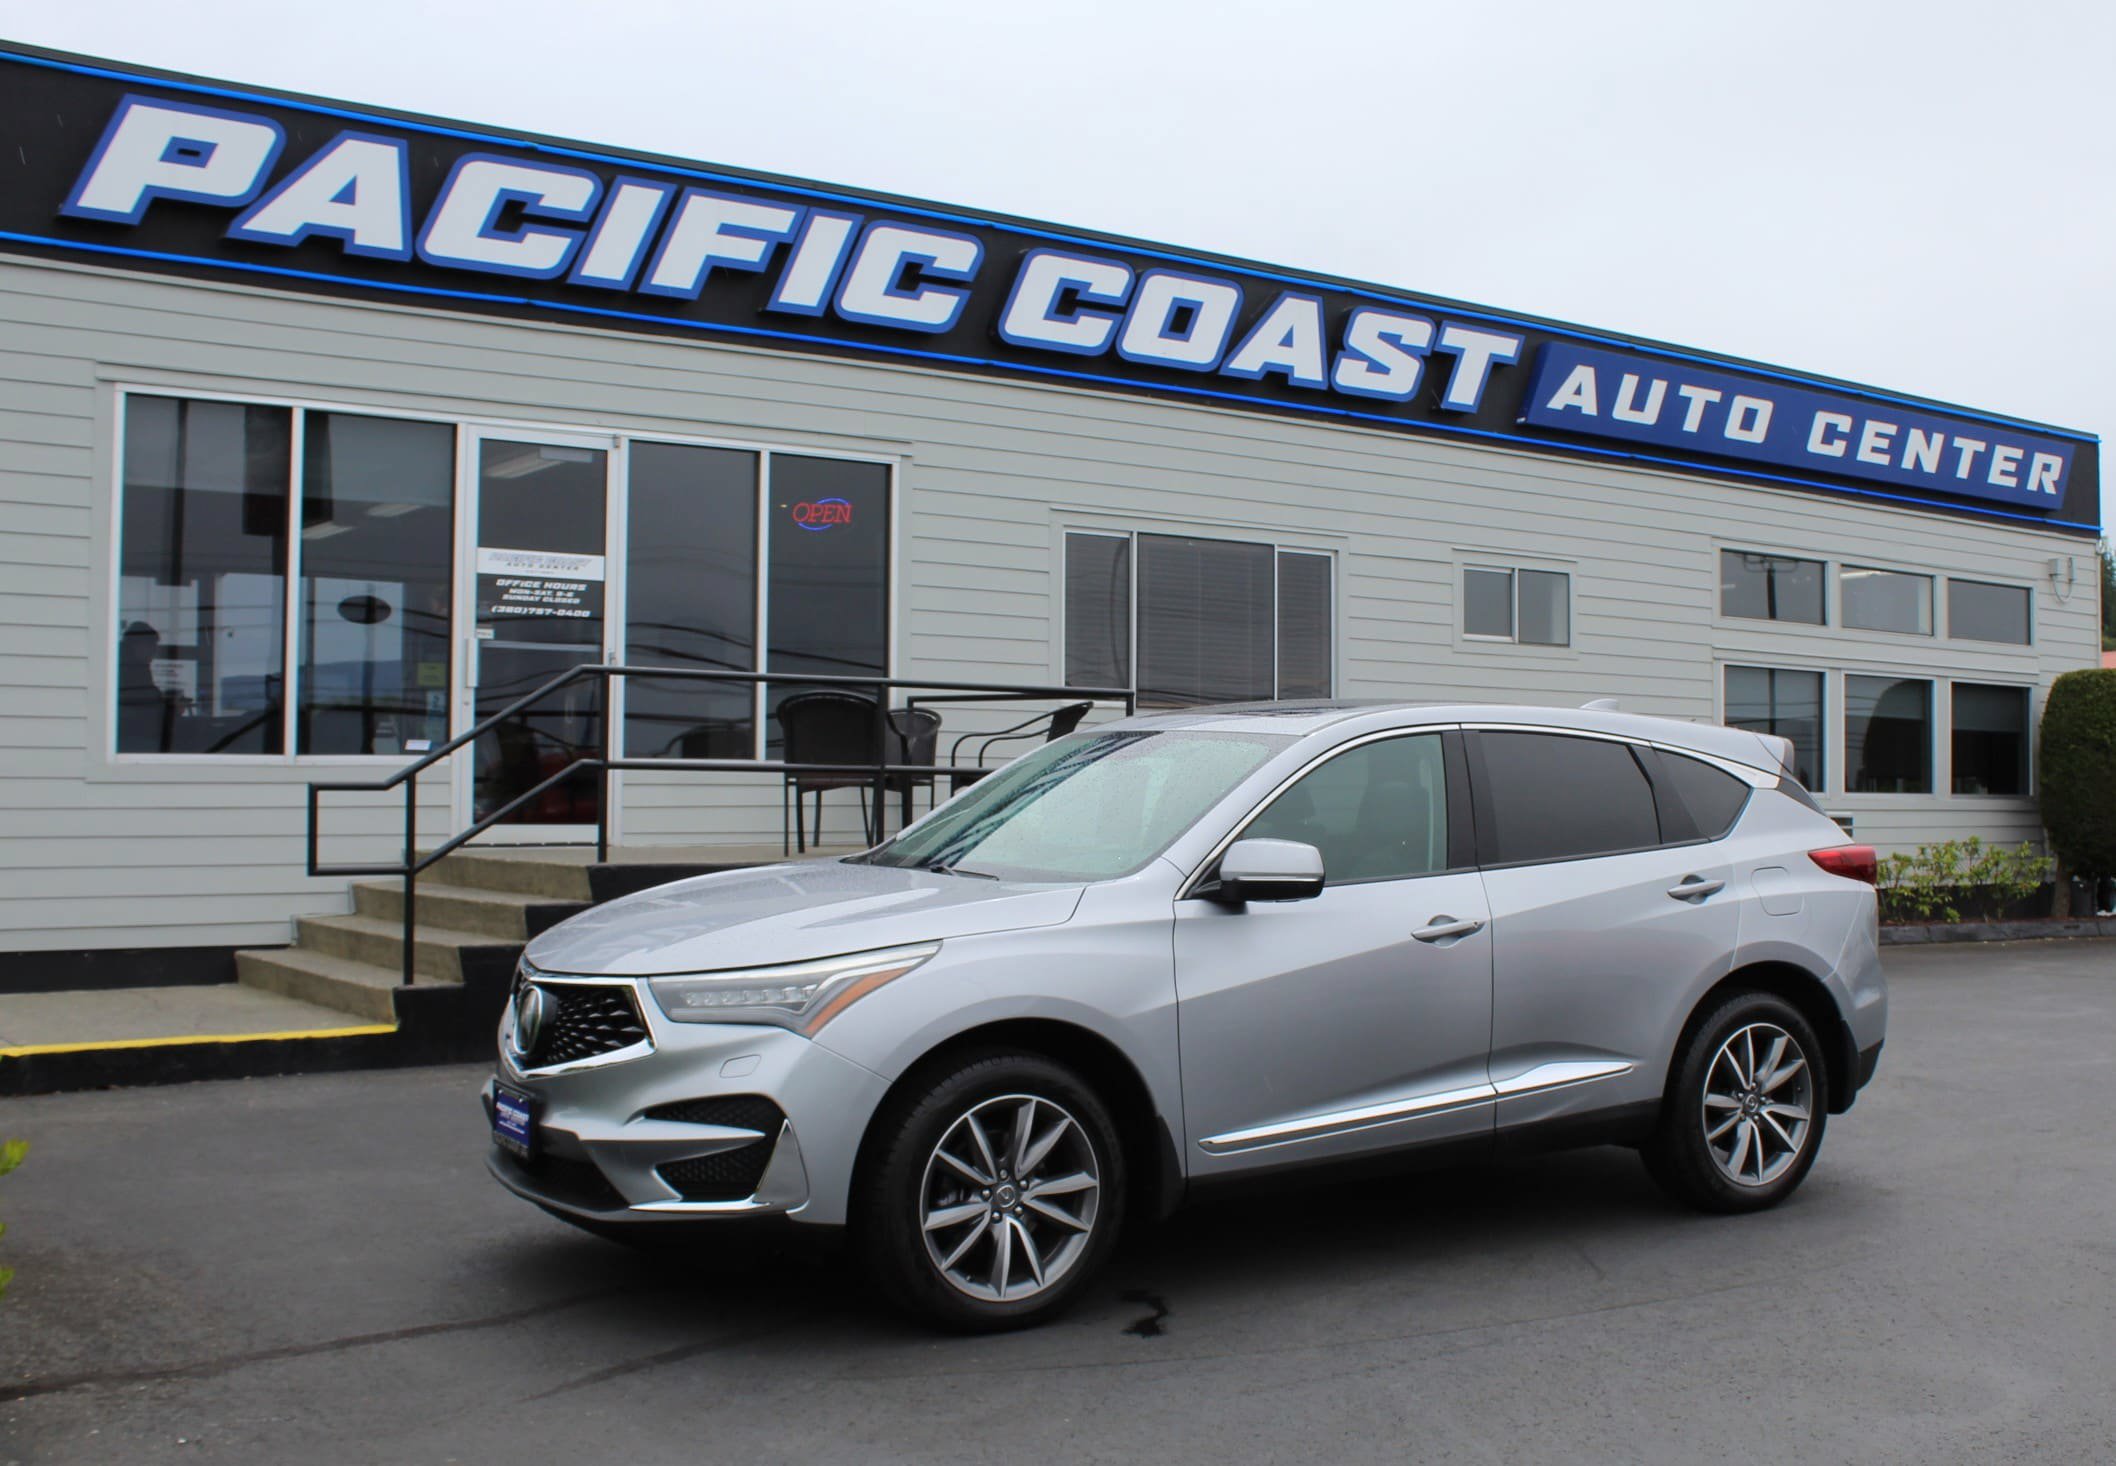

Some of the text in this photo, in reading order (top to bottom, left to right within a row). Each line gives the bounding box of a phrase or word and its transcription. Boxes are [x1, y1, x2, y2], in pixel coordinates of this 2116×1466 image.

[60, 94, 1525, 412] PACIFIC COAST
[1546, 365, 2063, 495] AUTO CENTER
[792, 501, 852, 524] OPEN
[496, 578, 587, 591] OFFICE HOURS
